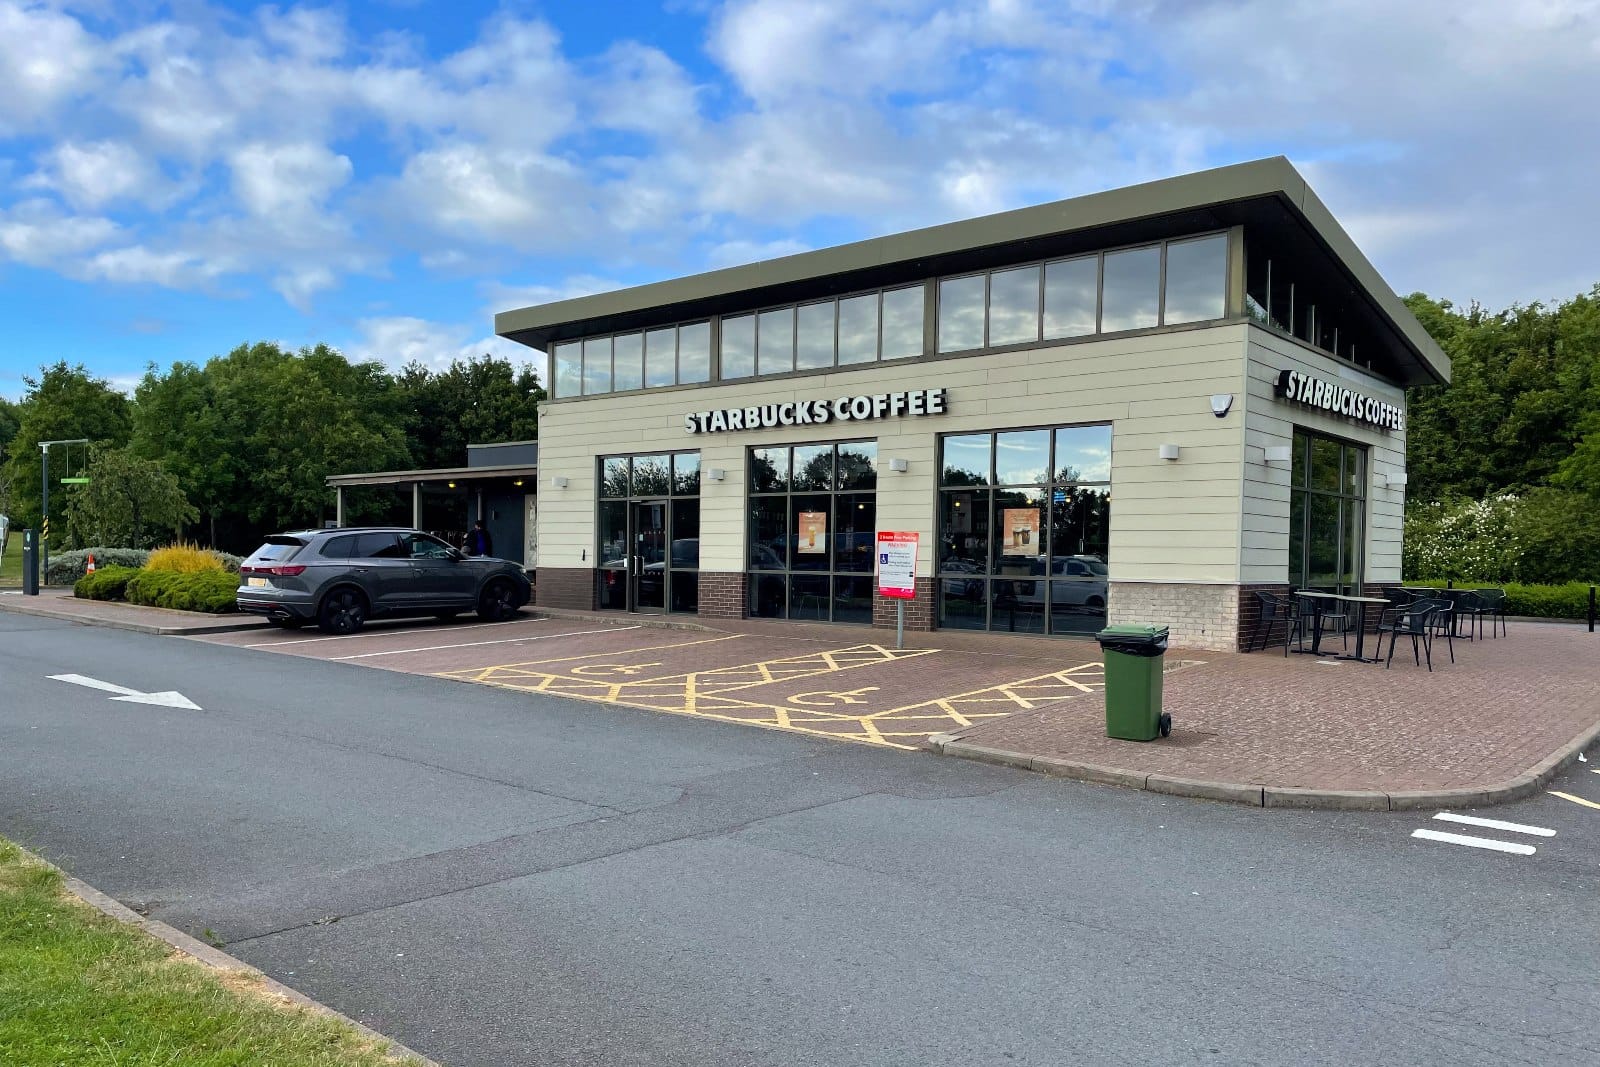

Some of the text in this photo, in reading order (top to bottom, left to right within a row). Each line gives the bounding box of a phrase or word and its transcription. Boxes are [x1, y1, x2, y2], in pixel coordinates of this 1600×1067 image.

[684, 388, 944, 435] STARBUCKS COFFEE
[1285, 370, 1404, 431] STARBUCKS COFFEE
